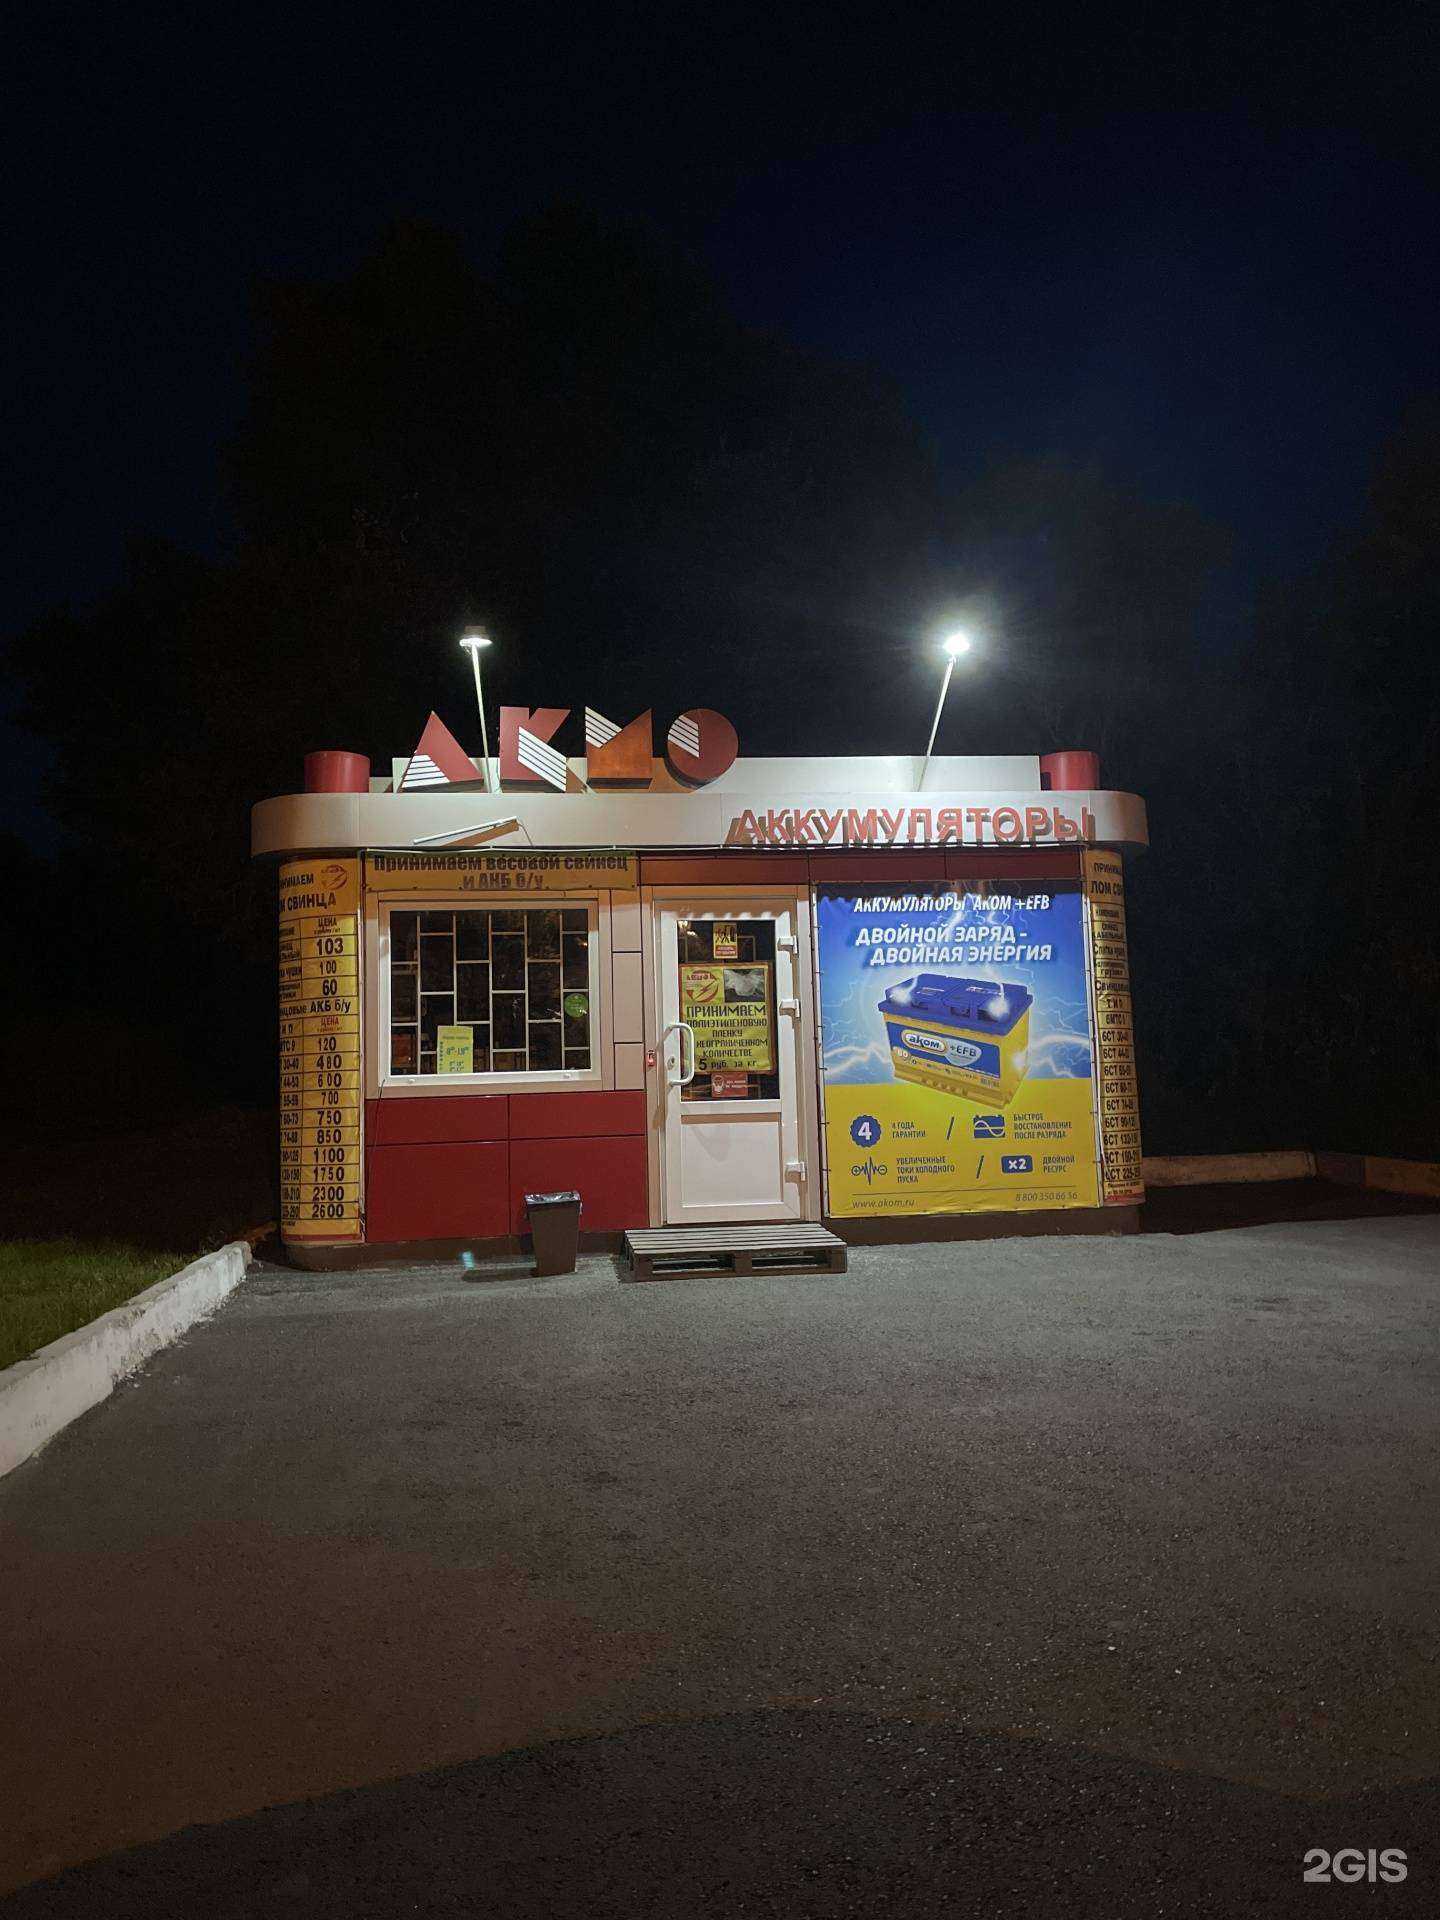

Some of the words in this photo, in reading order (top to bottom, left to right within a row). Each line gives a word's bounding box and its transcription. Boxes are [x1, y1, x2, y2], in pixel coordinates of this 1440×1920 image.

[733, 806, 1090, 843] АККУМУЛЯТОРЫ
[374, 854, 482, 872] Принимаем
[486, 854, 560, 871] весовой
[564, 855, 628, 871] свинец
[1090, 880, 1112, 894] ЛОМ
[287, 892, 337, 912] СВИНЦА
[854, 895, 967, 913] АККУМУЛЯТОРЫ
[972, 894, 1012, 911] АКОМ
[318, 916, 338, 927] ЦЕНА
[855, 923, 951, 946] ДВОЙНОЙ
[954, 925, 1016, 944] ЗАРЯД
[316, 937, 344, 956] 103
[869, 943, 964, 966] ДВОЙНАЯ
[967, 944, 1052, 962] ЭНЕРГИЯ
[319, 959, 337, 975] 100
[322, 978, 338, 996] 60
[309, 999, 331, 1013] АКБ
[334, 998, 351, 1014] б/у
[686, 1005, 766, 1018] ПРИНИМАЕМ
[320, 1017, 339, 1027] ЦЕНА
[712, 1029, 743, 1038] ПЛЕНКУ
[318, 1037, 337, 1051] 120
[696, 1039, 768, 1048] НЕОГРАНИЧЕННОМ
[909, 1034, 940, 1049] akom
[702, 1048, 753, 1058] КОЛИЧЕСТВЕ
[698, 1059, 708, 1071] 5
[317, 1072, 343, 1088] 600
[321, 1090, 339, 1106] 700
[317, 1110, 342, 1126] 750
[1013, 1113, 1044, 1121] БЫСТРОЕ
[857, 1121, 873, 1141] 4
[897, 1121, 915, 1129] ГОДА
[1013, 1121, 1073, 1130] ВОССТАНОВЛЕНИЕ
[316, 1129, 342, 1144] 850
[892, 1130, 926, 1138] ГАРАНТИИ
[1014, 1131, 1036, 1139] ПОСЛЕ
[1037, 1130, 1067, 1139] РАЗРЯДА
[313, 1147, 345, 1163] 1100
[896, 1156, 946, 1165] УВЕЛИЧЕННЫЕ
[1042, 1155, 1075, 1165] ДВОЙНОЙ
[313, 1166, 345, 1182] 1750
[896, 1166, 915, 1174] ТОКИ
[915, 1164, 955, 1174] ХОЛОДНОГО
[1043, 1165, 1067, 1173] РЕСУРС
[897, 1175, 919, 1184] ПУСКА
[312, 1185, 345, 1201] 2300
[1021, 1192, 1038, 1201] 800
[852, 1198, 915, 1208] www.akom.ru
[311, 1203, 345, 1218] 2600
